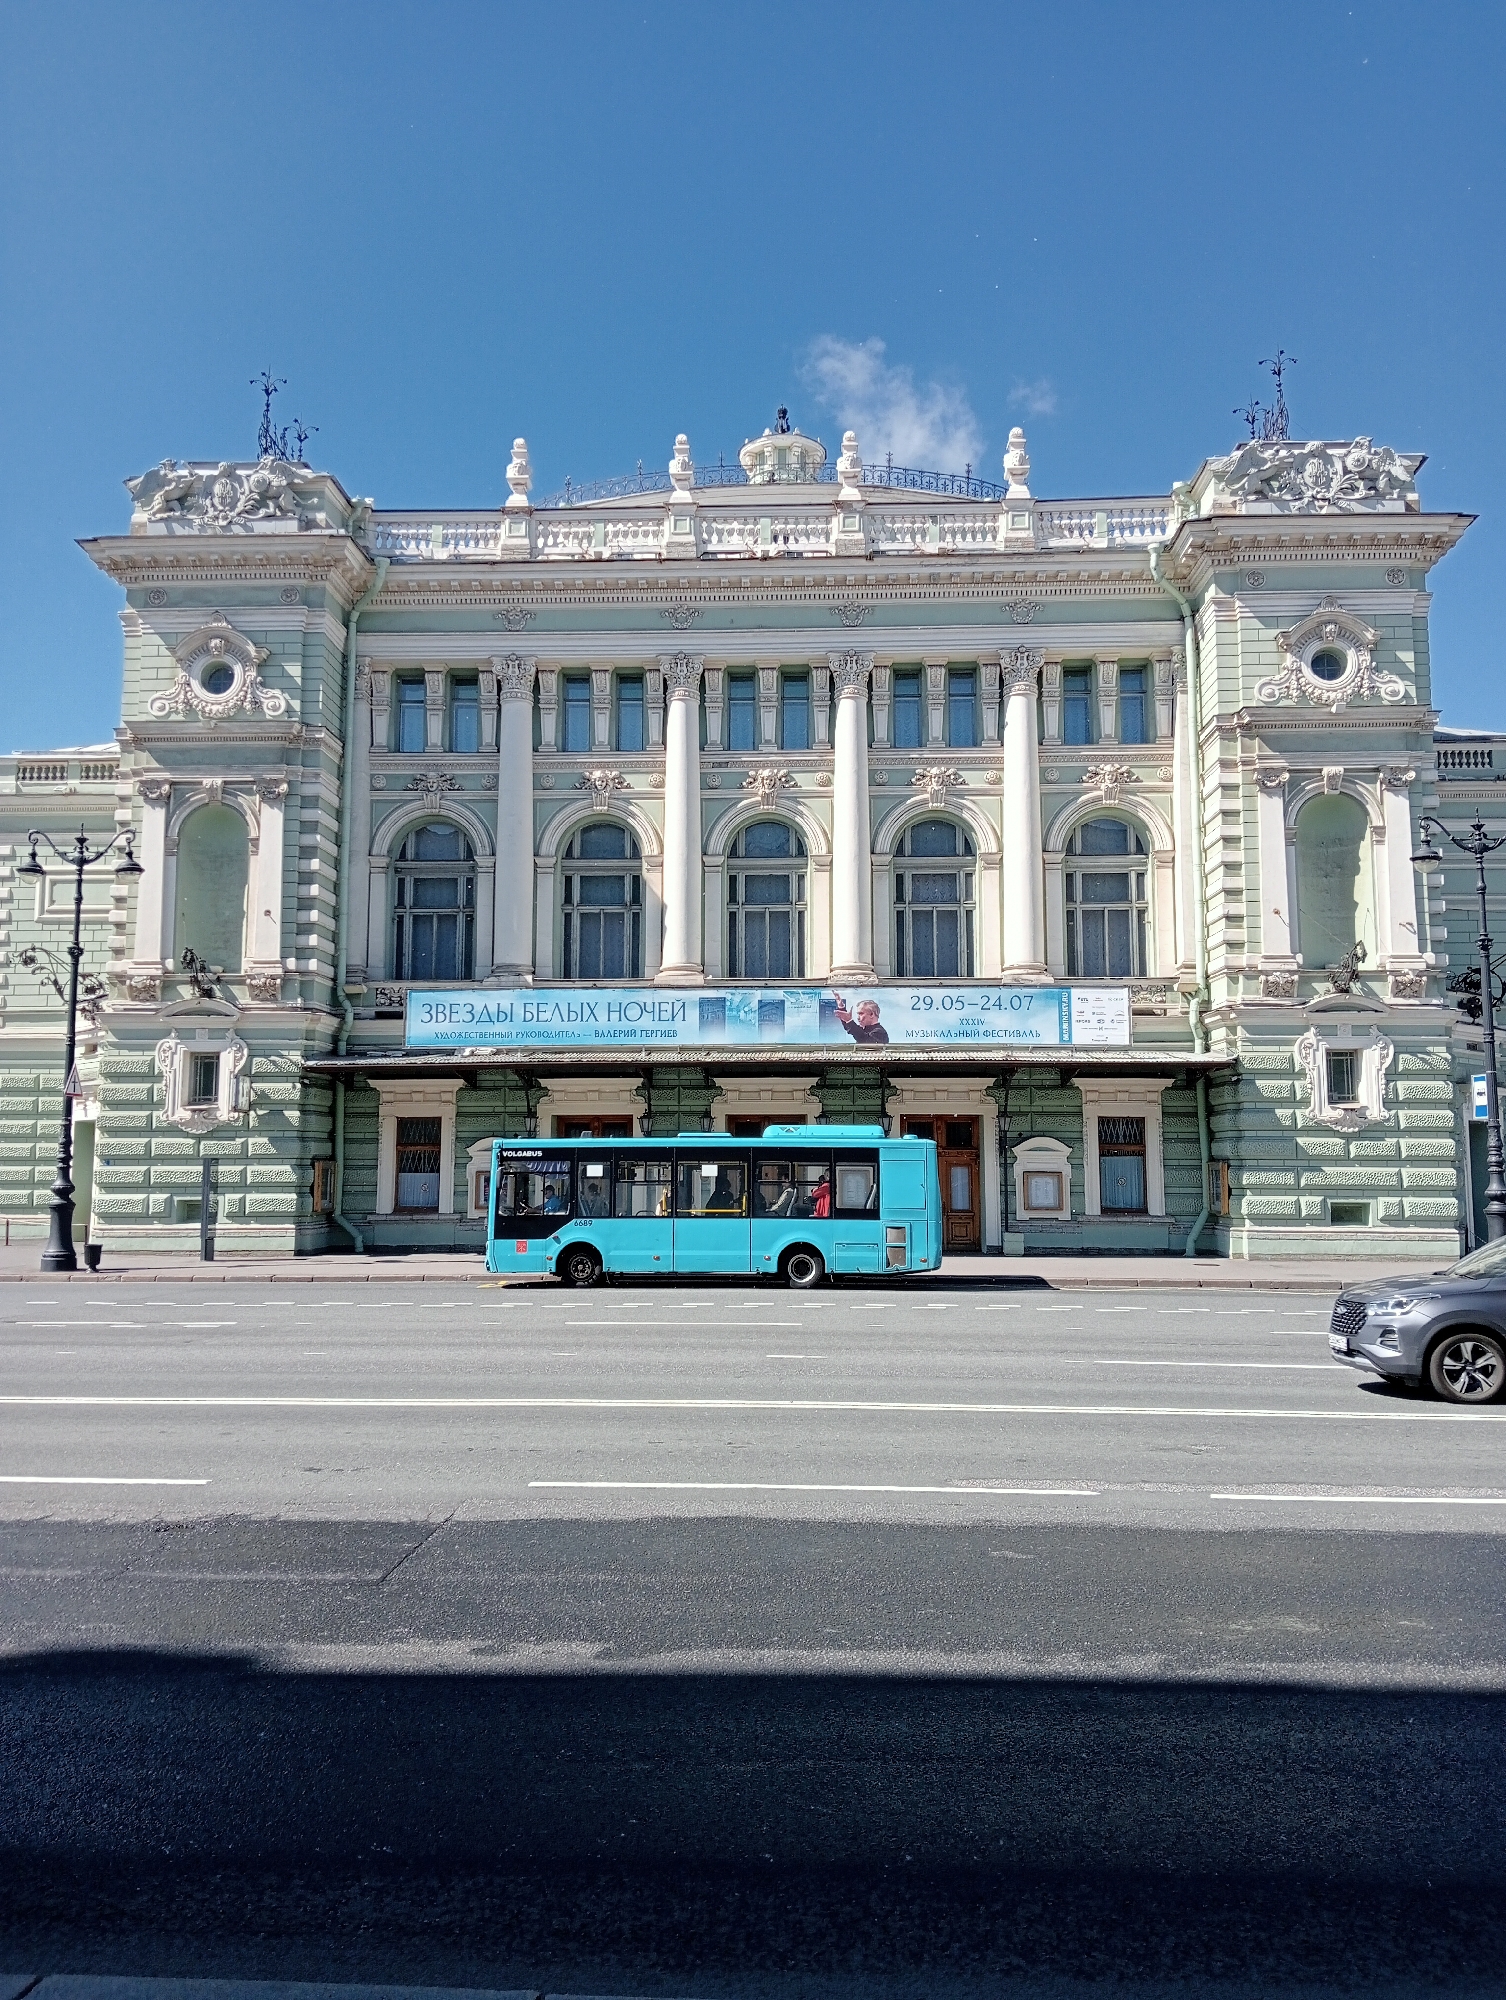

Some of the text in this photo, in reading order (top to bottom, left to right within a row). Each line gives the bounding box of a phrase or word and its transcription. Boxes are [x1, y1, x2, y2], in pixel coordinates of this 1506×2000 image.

[420, 998, 687, 1025] ЗВЕЗДЫ БЕЛЫХ НОЧЕЙ
[959, 1018, 986, 1026] XXXIV
[434, 1031, 513, 1040] ХУДОЖЕСТВЕННЫЙ
[515, 1030, 581, 1039] РУКОВОДИТЕЛЬ
[594, 1028, 637, 1038] ВАЛЕРИЙ
[639, 1029, 678, 1038] ГЕРГИЕВ
[905, 1029, 1041, 1038] МУЗЫКАЛЬНЫЙ ФЕСТИВАЛЬ
